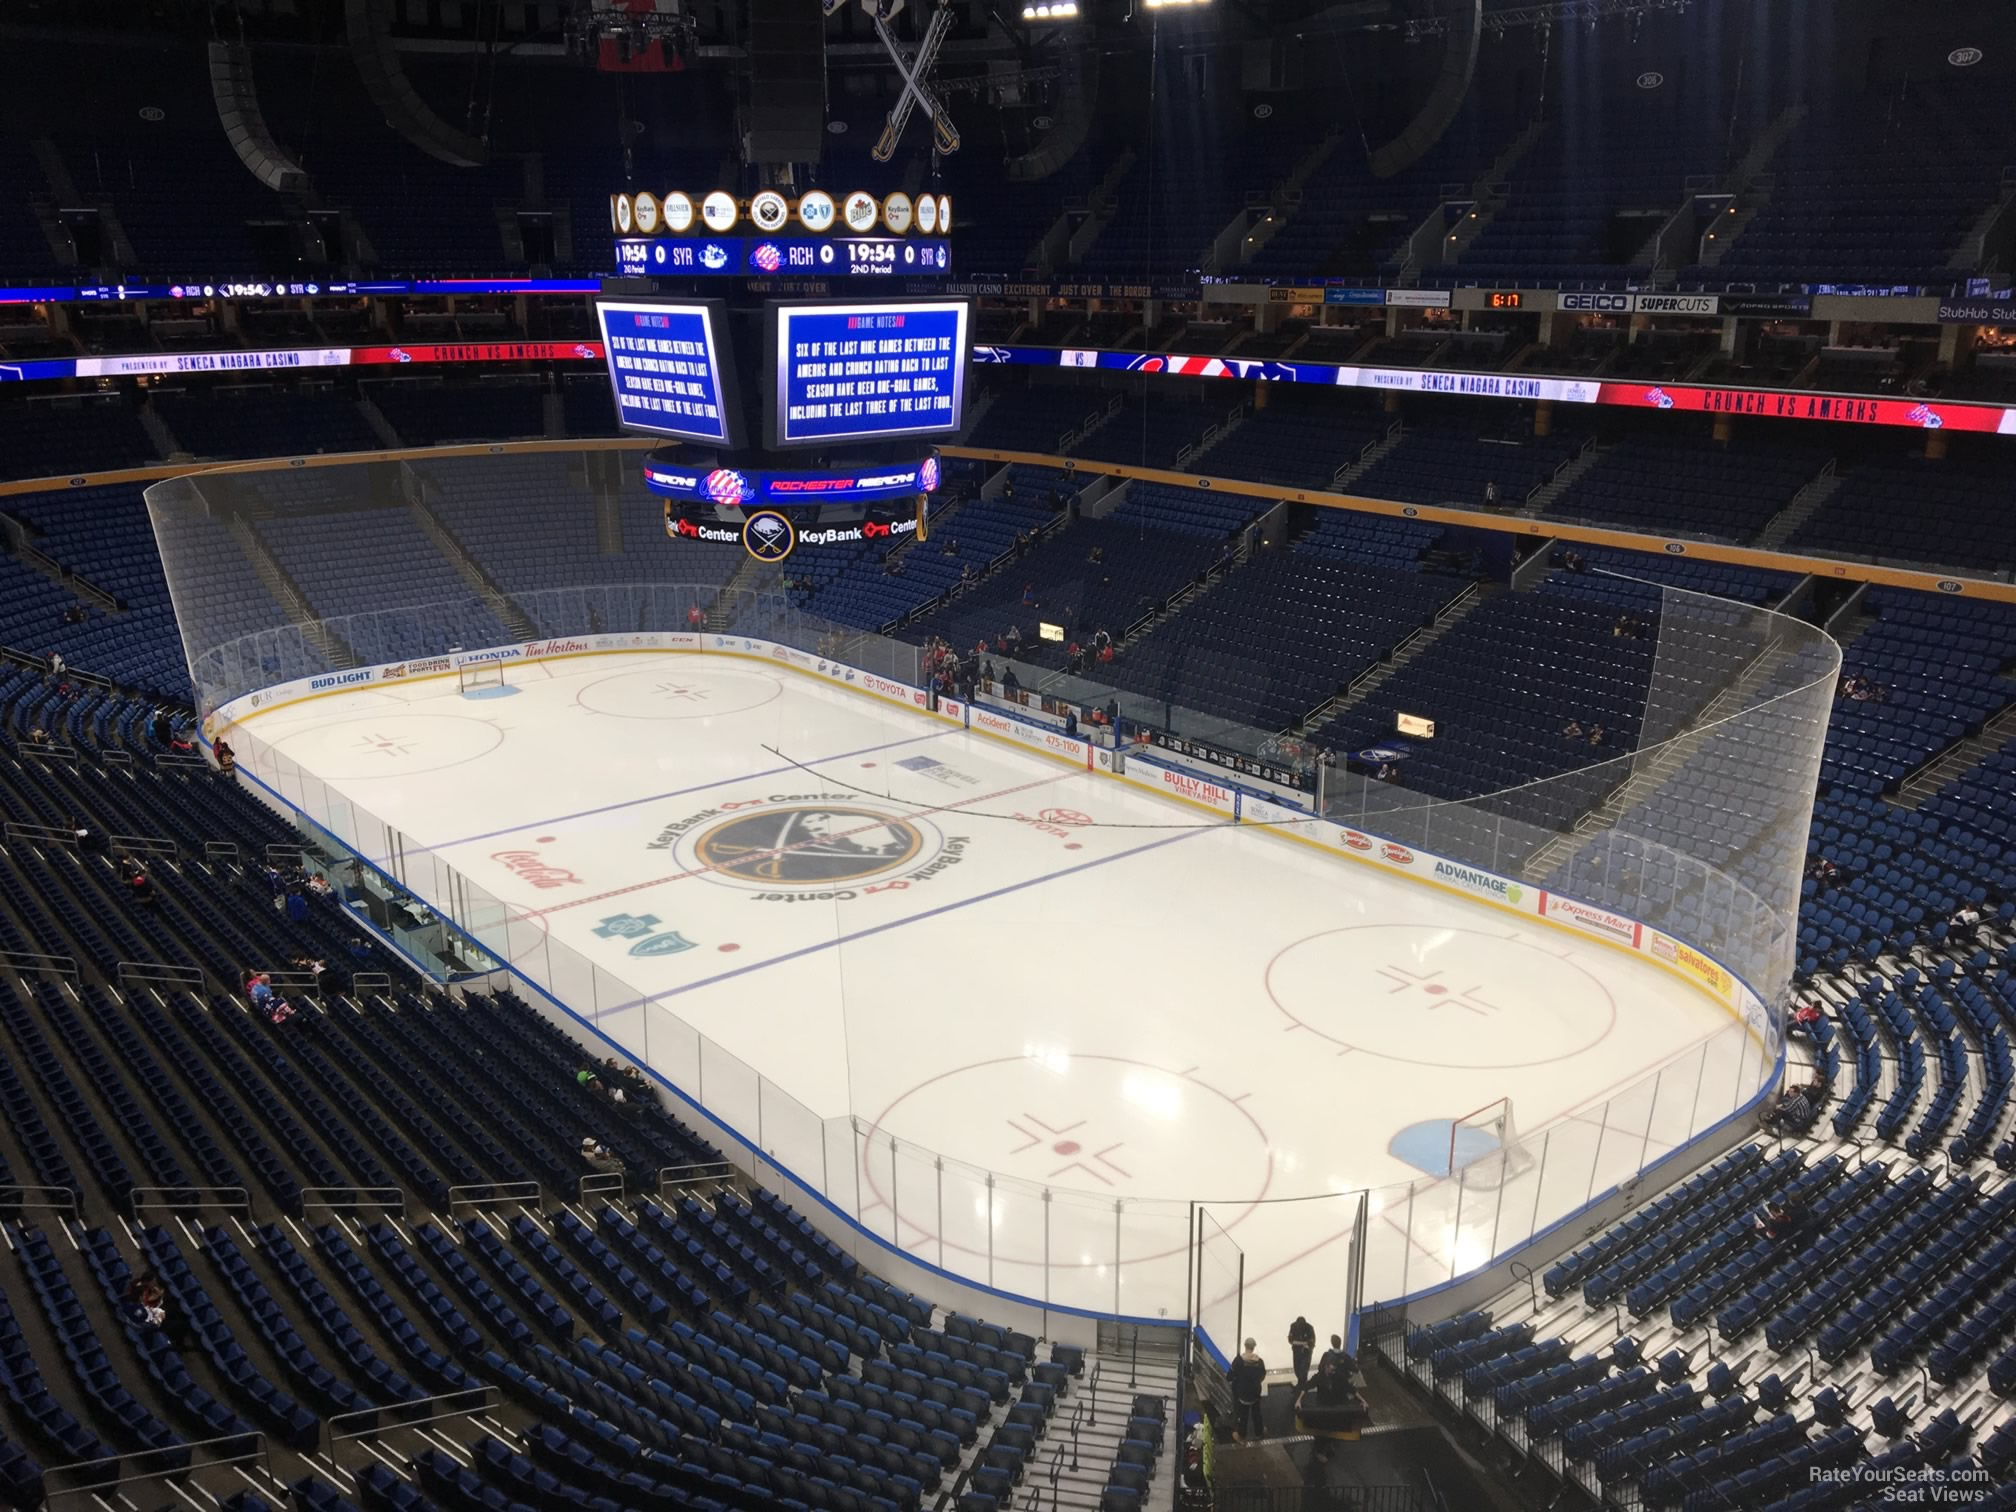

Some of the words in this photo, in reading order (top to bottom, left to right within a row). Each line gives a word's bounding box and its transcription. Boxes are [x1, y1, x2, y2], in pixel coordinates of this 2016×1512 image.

[1957, 52, 1975, 63] 307
[850, 205, 873, 223] Blue
[621, 245, 647, 262] 19:54
[655, 245, 666, 263] 0
[673, 247, 693, 266] SYR
[789, 247, 814, 265] RCH
[820, 245, 834, 263] 0
[848, 244, 896, 262] 19:54
[905, 245, 915, 263] 0
[921, 247, 933, 265] SYR
[851, 264, 869, 274] 2ND
[871, 264, 892, 274] Period
[186, 286, 201, 296] RCH
[203, 285, 213, 297] 0
[227, 284, 264, 296] 19:54
[275, 284, 285, 296] 0
[290, 284, 305, 294] SYR
[946, 284, 977, 295] FALLSVIEW
[978, 284, 1002, 295] CASINO
[1004, 285, 1051, 296] EXCITEMENT
[1058, 285, 1079, 296] JUST
[1081, 285, 1102, 296] OVER
[1109, 286, 1122, 296] THE
[1123, 286, 1151, 297] BORDER
[1493, 294, 1518, 307] 6:17
[1564, 295, 1627, 310] GEICO
[1639, 297, 1710, 312] SUPERCUTS
[1771, 303, 1809, 311] SPORTS
[1939, 306, 1988, 319] StubHub
[857, 316, 874, 329] GAME
[876, 315, 896, 328] NOTES
[434, 347, 479, 361] CRUNCH
[488, 346, 501, 359] VS
[509, 345, 554, 359] AMERKS
[796, 342, 809, 357] SIX
[811, 342, 821, 356] OF
[824, 341, 837, 356] THE
[839, 340, 858, 355] LAST
[860, 340, 877, 354] NINE
[878, 339, 903, 354] GAMES
[904, 338, 936, 353] BETWEEN
[938, 337, 951, 350] THE
[121, 361, 157, 371] PRESENTED
[160, 360, 168, 369] BY
[178, 356, 215, 371] SENECA
[220, 354, 262, 370] NIAGARA
[266, 352, 299, 366] CASINO
[829, 362, 843, 377] AND
[845, 361, 872, 376] CRUNCH
[875, 359, 900, 374] DATING
[901, 358, 919, 373] BACK
[921, 358, 930, 372] TO
[932, 356, 949, 371] LAST
[1075, 352, 1084, 366] VS
[806, 383, 834, 399] SEASON
[836, 382, 855, 397] HAVE
[857, 381, 875, 396] BEEN
[877, 379, 911, 394] ONE-GOAL
[913, 377, 939, 392] GAMES,
[1373, 375, 1404, 385] PRESENTED
[1405, 376, 1413, 386] BY
[1421, 375, 1455, 391] SENECA
[1460, 377, 1500, 395] NIAGARA
[1505, 379, 1541, 397] CASINO
[789, 405, 827, 420] INCLUDING
[829, 404, 843, 417] THE
[845, 403, 863, 416] LAST
[865, 401, 887, 415] THREE
[889, 400, 898, 413] OF
[900, 399, 912, 412] THE
[914, 397, 932, 411] LAST
[933, 395, 952, 409] FOUR.
[1704, 390, 1765, 414] CRUNCH
[1777, 396, 1796, 416] VS
[1807, 398, 1878, 421] AMERKS
[770, 479, 854, 491] ROCHESTER
[857, 472, 915, 488] AMERICANS
[698, 526, 740, 542] Center
[799, 528, 862, 545] KeyBank
[890, 518, 917, 535] Center
[1669, 544, 1681, 553] 106
[1944, 582, 1957, 592] 107
[468, 649, 521, 662] HONDA
[524, 644, 545, 658] Tim
[546, 640, 589, 656] Hortons
[428, 658, 450, 666] DRINK
[433, 662, 451, 672] FUN
[311, 678, 335, 690] BUD
[336, 671, 371, 685] LIGHT
[875, 679, 906, 698] TOYOTA
[977, 713, 1011, 732] Accident?
[1046, 735, 1080, 754] 475-1100
[1164, 771, 1199, 790] BULLY
[1203, 783, 1230, 801] HILL
[1175, 785, 1218, 805] VINEYARDS
[646, 808, 720, 851] KeyBank
[767, 792, 859, 802] Center
[1012, 812, 1069, 839] TOYOTA
[908, 836, 970, 883] KeyBank
[490, 850, 585, 889] Coca-Cola
[1435, 861, 1507, 894] ADVANTAGE
[1435, 872, 1461, 886] FEDERAL
[1463, 881, 1484, 893] CREDIT
[1485, 888, 1507, 900] UNION
[751, 890, 857, 903] Center
[1561, 902, 1602, 921] Express
[1604, 915, 1633, 932] Mart
[1679, 949, 1719, 981] salvatores
